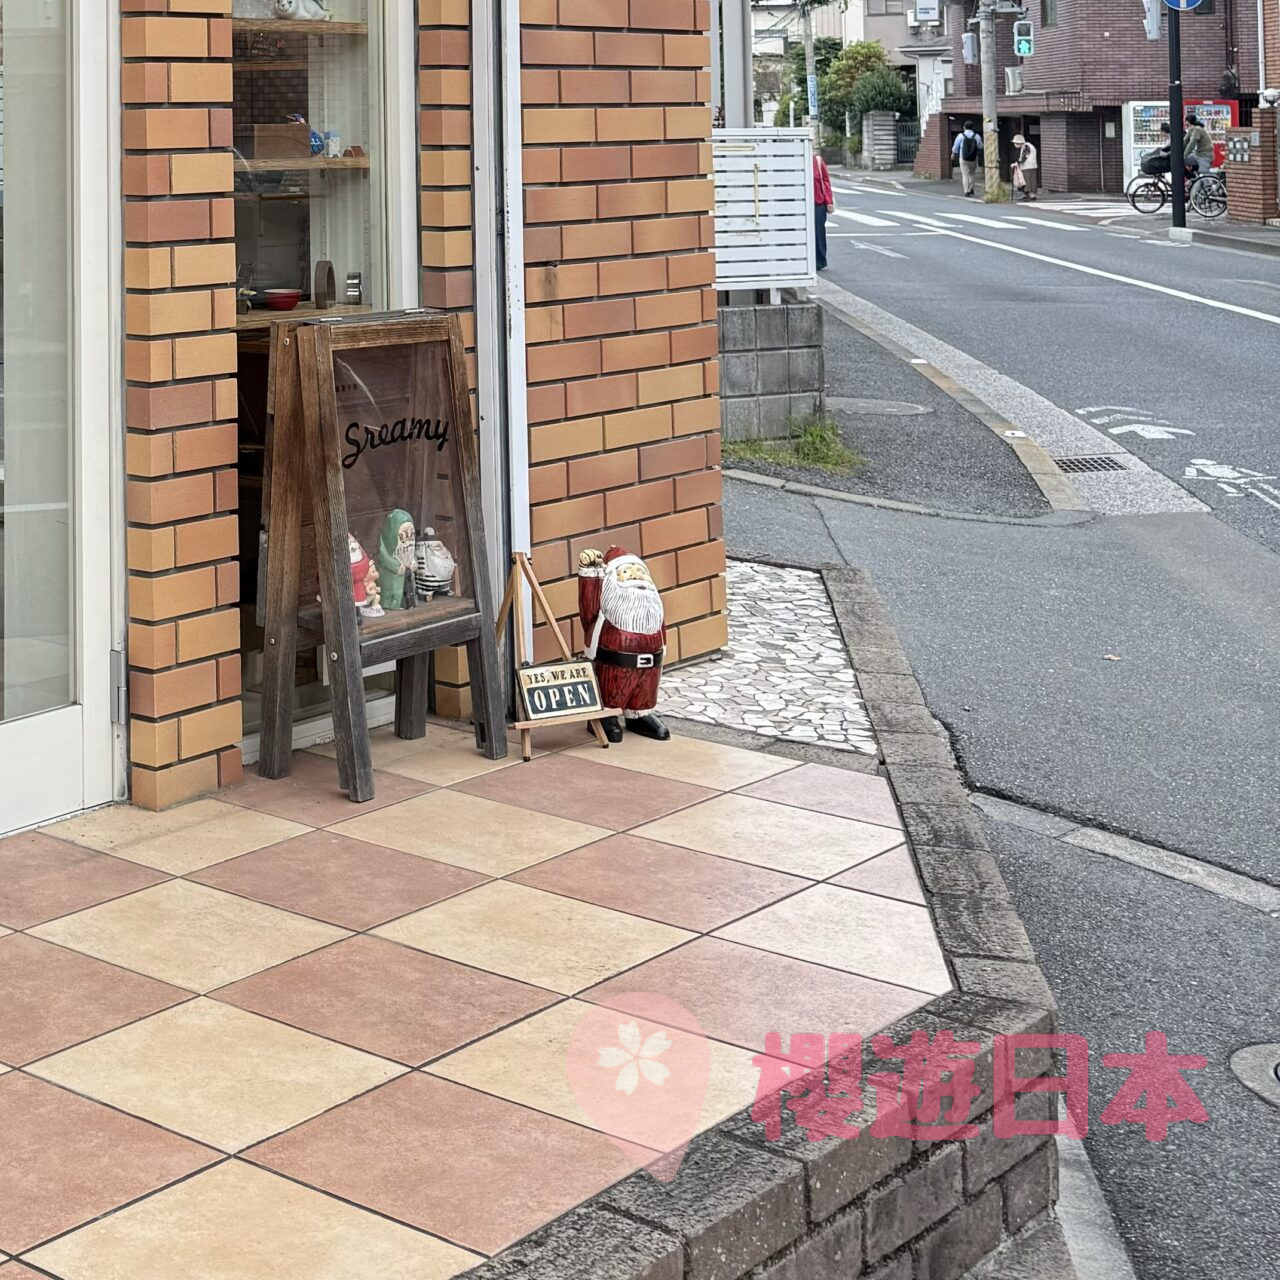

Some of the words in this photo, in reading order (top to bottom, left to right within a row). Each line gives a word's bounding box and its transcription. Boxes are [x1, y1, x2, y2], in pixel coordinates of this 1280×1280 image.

[342, 417, 449, 469] Sreamy
[526, 672, 550, 684] YES,
[551, 669, 567, 681] WE
[569, 667, 589, 679] ARE
[533, 683, 591, 711] OPEN
